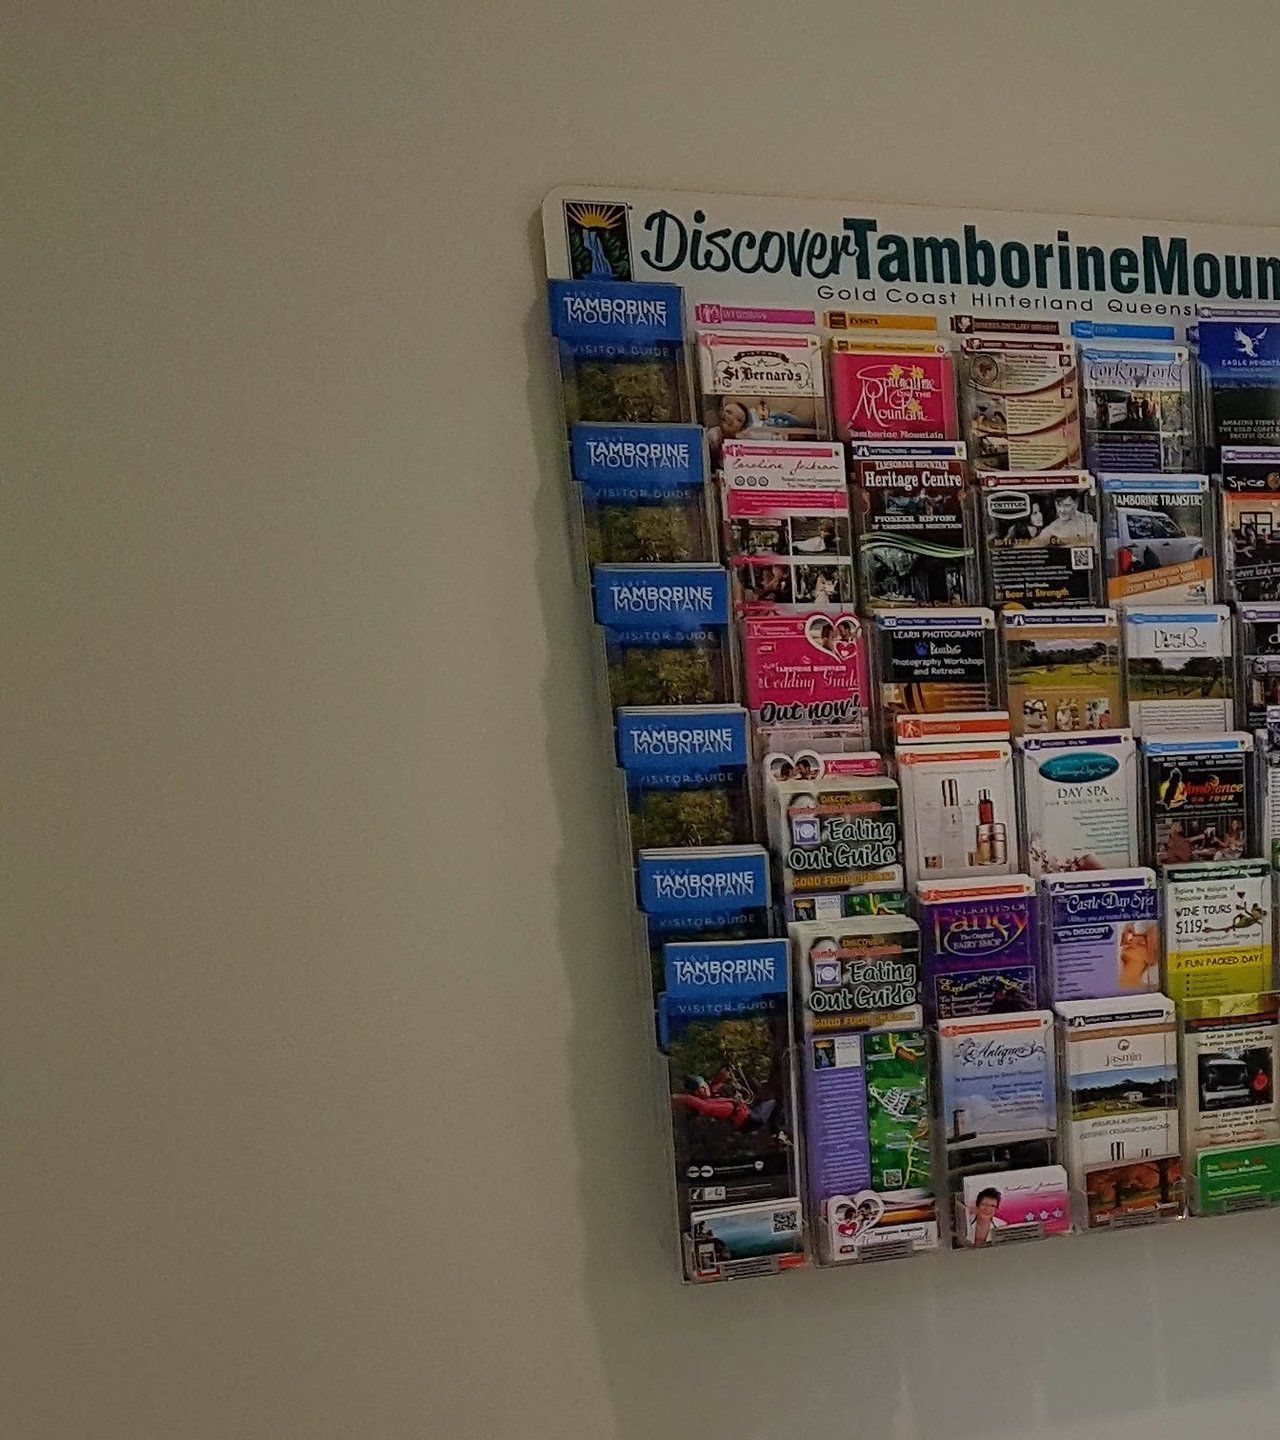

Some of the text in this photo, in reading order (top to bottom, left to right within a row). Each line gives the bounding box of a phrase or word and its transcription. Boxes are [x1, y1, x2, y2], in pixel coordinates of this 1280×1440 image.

[563, 297, 667, 315] TAMBORINE
[817, 284, 876, 303] Gold
[886, 286, 958, 306] Coast
[971, 290, 1093, 314] Hinterland
[1107, 299, 1199, 318] Queensl
[567, 309, 667, 326] MOUNTAIN
[742, 366, 801, 381] Bernards
[901, 431, 944, 440] Mountain
[586, 442, 689, 457] TAMBORINE
[591, 452, 689, 469] MOUNTAIN
[865, 471, 962, 491] Heritage Centre
[1227, 476, 1266, 491] Spice
[1112, 494, 1159, 507] TAMBORINE
[874, 514, 956, 523] PIONEER HISTORY
[610, 586, 713, 600] TAMBORINE
[614, 598, 713, 611] MOUNTAIN
[893, 630, 984, 639] LEARN PHOTOGRAPHY
[913, 667, 965, 676] and Retreats
[761, 693, 860, 723] Out now!
[630, 728, 732, 743] TAMBORINE
[634, 741, 732, 755] MOUNTAIN
[1057, 786, 1110, 799] DAY SPA
[825, 818, 896, 845] Eating
[788, 842, 897, 870] Out Guide
[652, 871, 754, 888] TAMBORINE
[657, 884, 754, 899] MOUNTAIN
[1066, 890, 1155, 913] Castle Day Spa
[1175, 904, 1232, 917] WINE TOURS
[1073, 926, 1109, 935] DISCOUNT
[673, 957, 775, 974] TAMBORINE
[1185, 959, 1204, 968] FUN
[1206, 956, 1239, 966] PACKED
[677, 971, 774, 985] MOUNTAIN
[849, 960, 917, 986] Eating
[808, 986, 917, 1012] Out Guide
